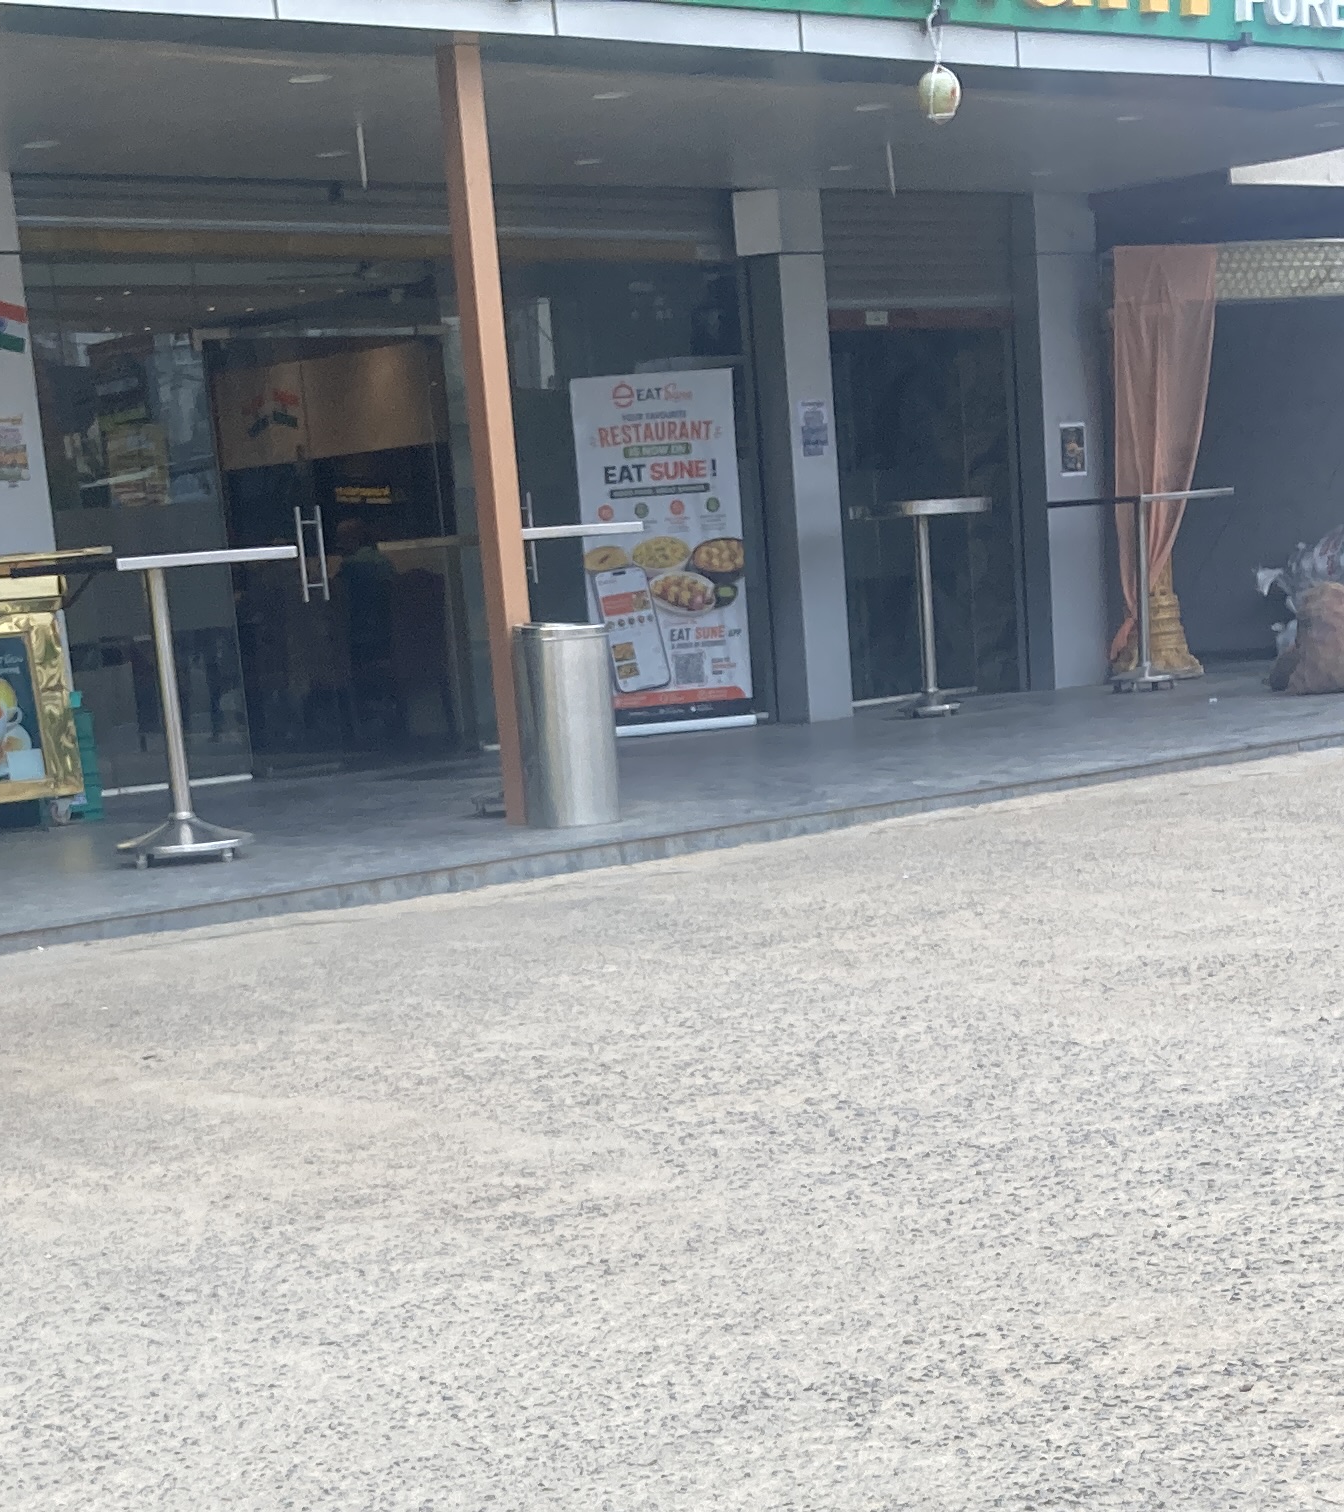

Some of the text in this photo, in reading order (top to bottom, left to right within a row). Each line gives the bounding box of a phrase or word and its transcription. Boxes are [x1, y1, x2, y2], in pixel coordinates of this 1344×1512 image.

[636, 387, 662, 401] EAT
[598, 420, 713, 447] RESTAURANT
[604, 464, 646, 484] EAT
[670, 628, 691, 642] EAT
[695, 625, 725, 640] SUNE
